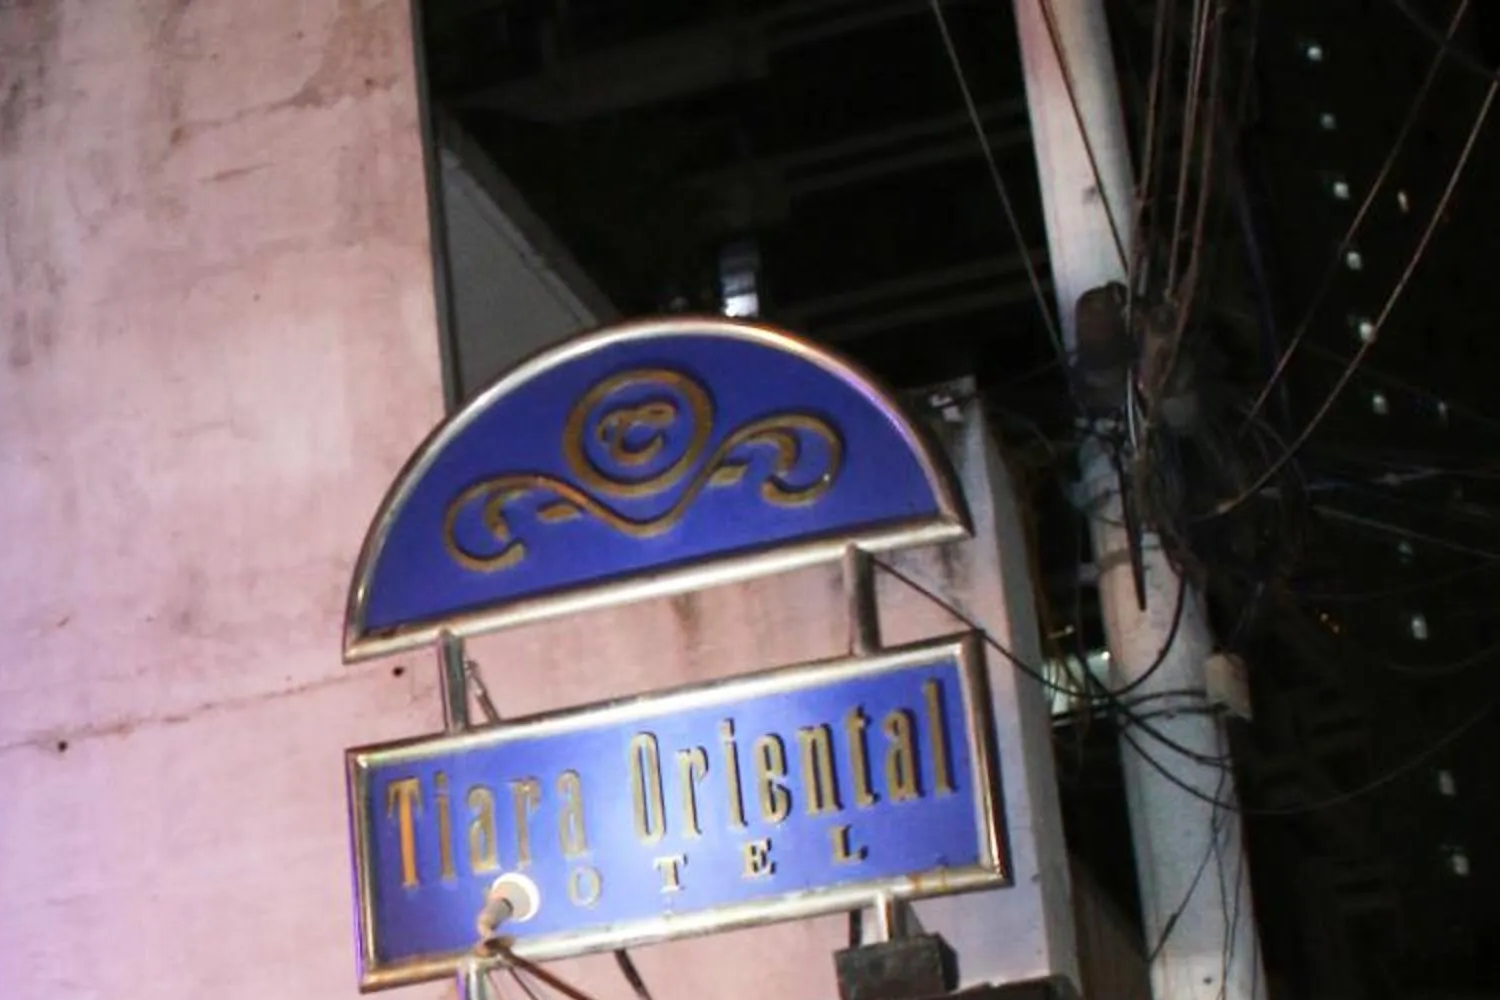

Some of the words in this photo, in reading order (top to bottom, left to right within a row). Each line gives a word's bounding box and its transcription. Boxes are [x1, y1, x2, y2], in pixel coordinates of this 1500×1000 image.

[386, 768, 590, 888] Tiara
[630, 678, 958, 843] Oriental
[566, 824, 870, 908] OTEL
